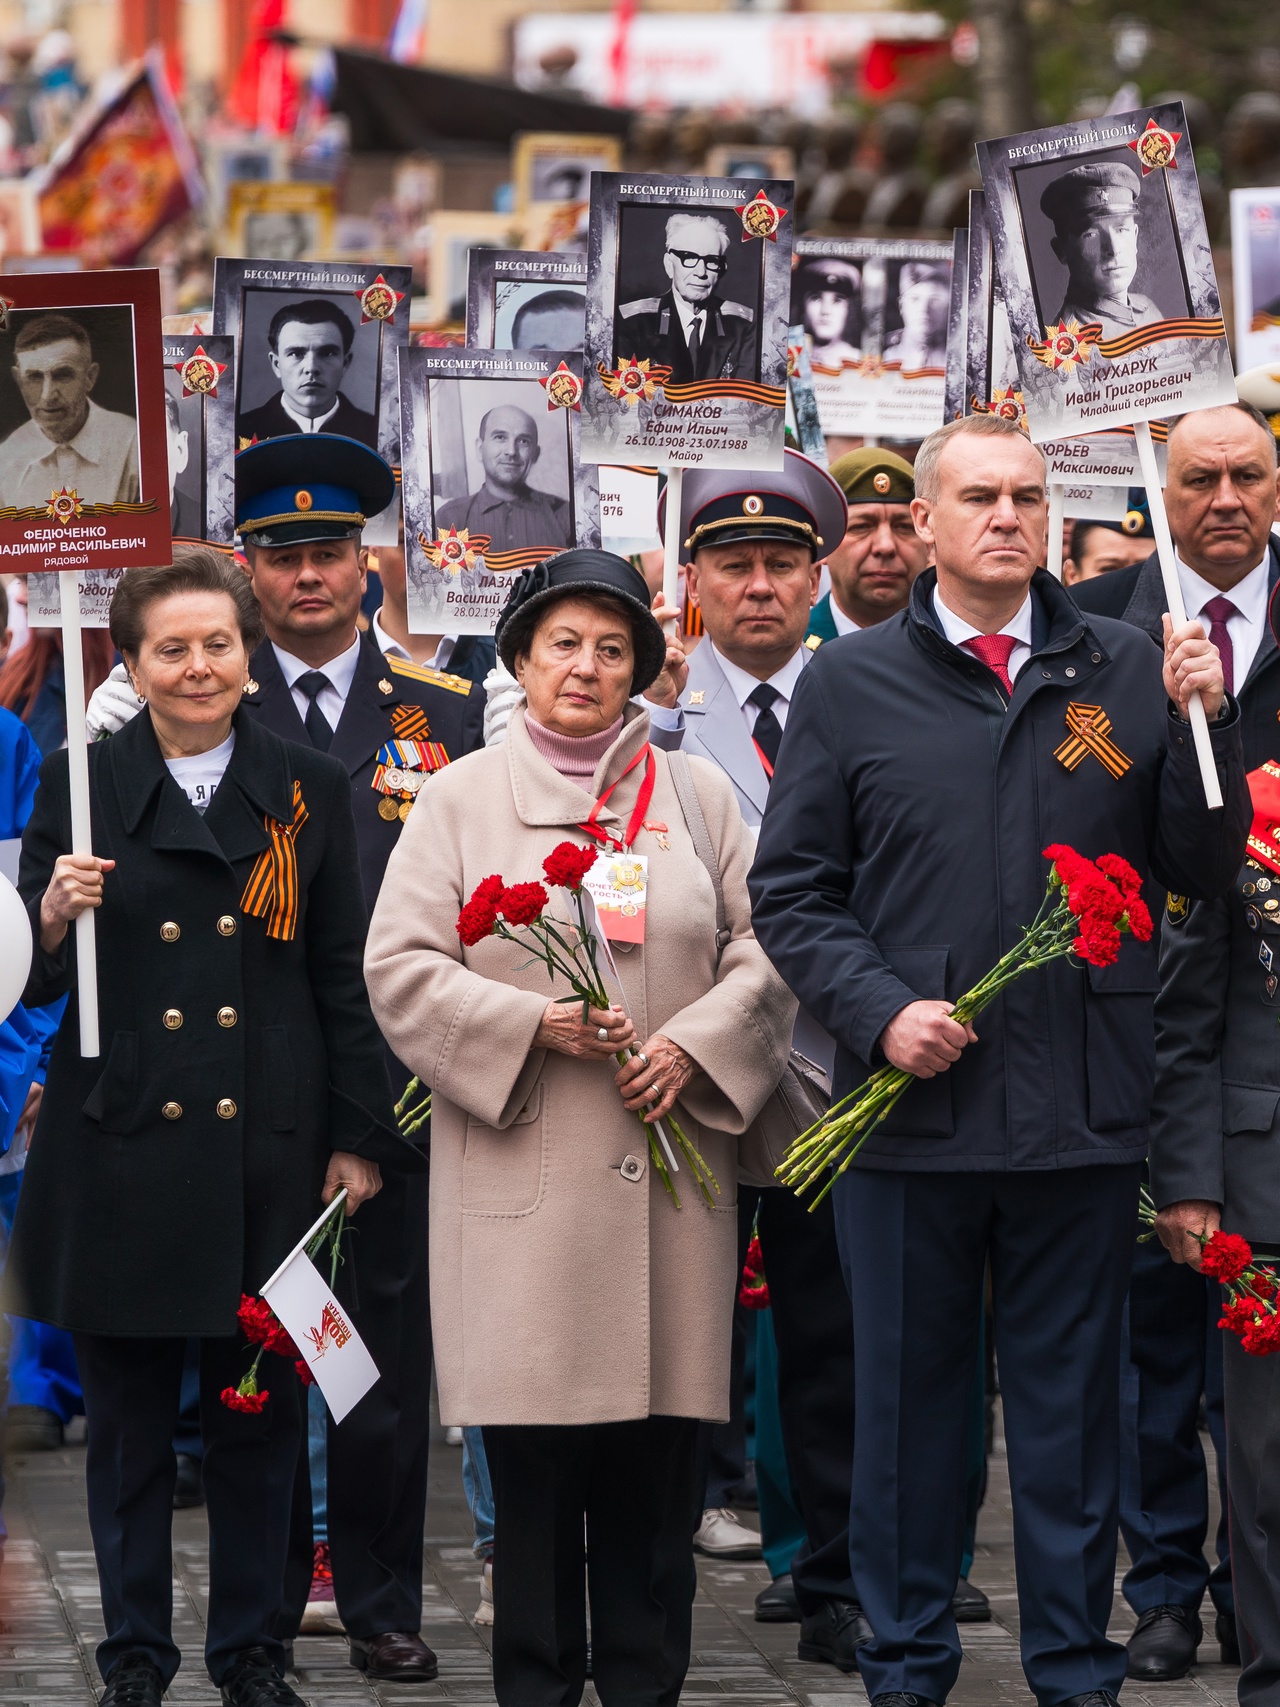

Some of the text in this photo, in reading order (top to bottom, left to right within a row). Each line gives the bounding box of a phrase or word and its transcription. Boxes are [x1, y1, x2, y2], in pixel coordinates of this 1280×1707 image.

[1008, 123, 1137, 159] БЕССМЕРТНЫЙ ПОЛК
[620, 184, 746, 200] БЕССМЕРТНЫЙ ПОЛК
[494, 260, 582, 273] БЕССМЕРТНЫЙ
[243, 269, 366, 284] БЕССМЕРТНЫЙ ПОЛК
[426, 358, 549, 371] БЕССМЕРТНЫЙ ПОЛК
[1092, 357, 1158, 383] КУХАРУК
[1065, 372, 1192, 407] Иван Григорьевич
[654, 404, 722, 418] СИМАКОВ
[1080, 391, 1183, 418] Младший сержант
[645, 420, 728, 436] Ефим Ильич
[625, 435, 748, 450] 26.10.1908-23.07.1988
[668, 450, 703, 463] Майор
[1051, 461, 1134, 476] Максимович
[23, 526, 107, 541] ФЕДЮЧЕНКО
[60, 537, 146, 553] ВАСИЛЬЕВИЧ
[44, 555, 89, 568] рядовой
[446, 591, 500, 604] Василий
[80, 607, 103, 616] Орден
[593, 890, 623, 900] ГОСТЬ
[327, 1300, 352, 1339] ПОБЕДА!
[329, 1322, 348, 1349] 80
